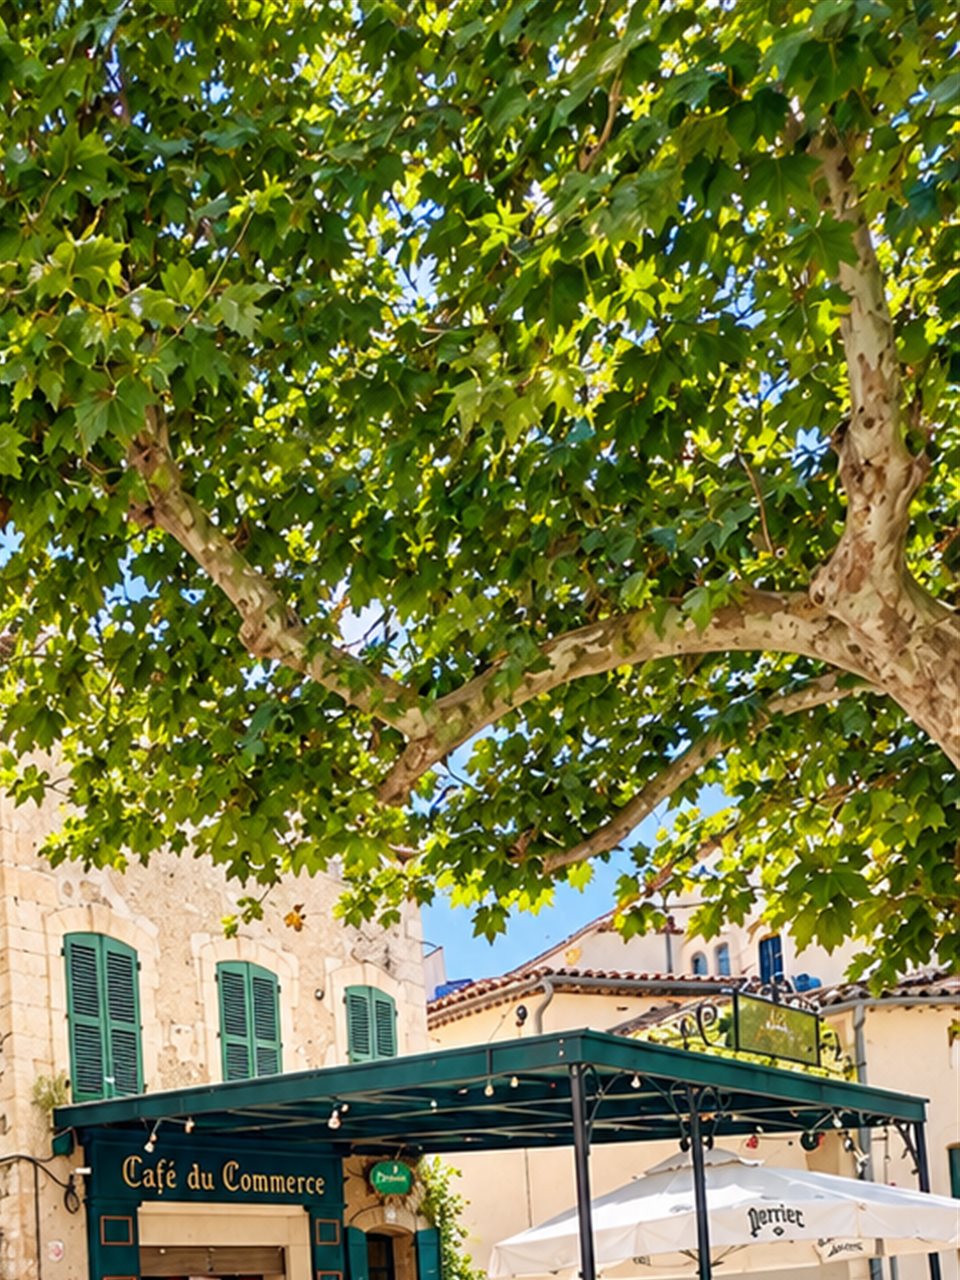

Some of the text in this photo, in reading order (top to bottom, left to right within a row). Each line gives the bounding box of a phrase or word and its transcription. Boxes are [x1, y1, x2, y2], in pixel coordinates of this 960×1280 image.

[122, 1155, 326, 1195] Café du Commerce
[747, 1204, 805, 1238] Perrier
